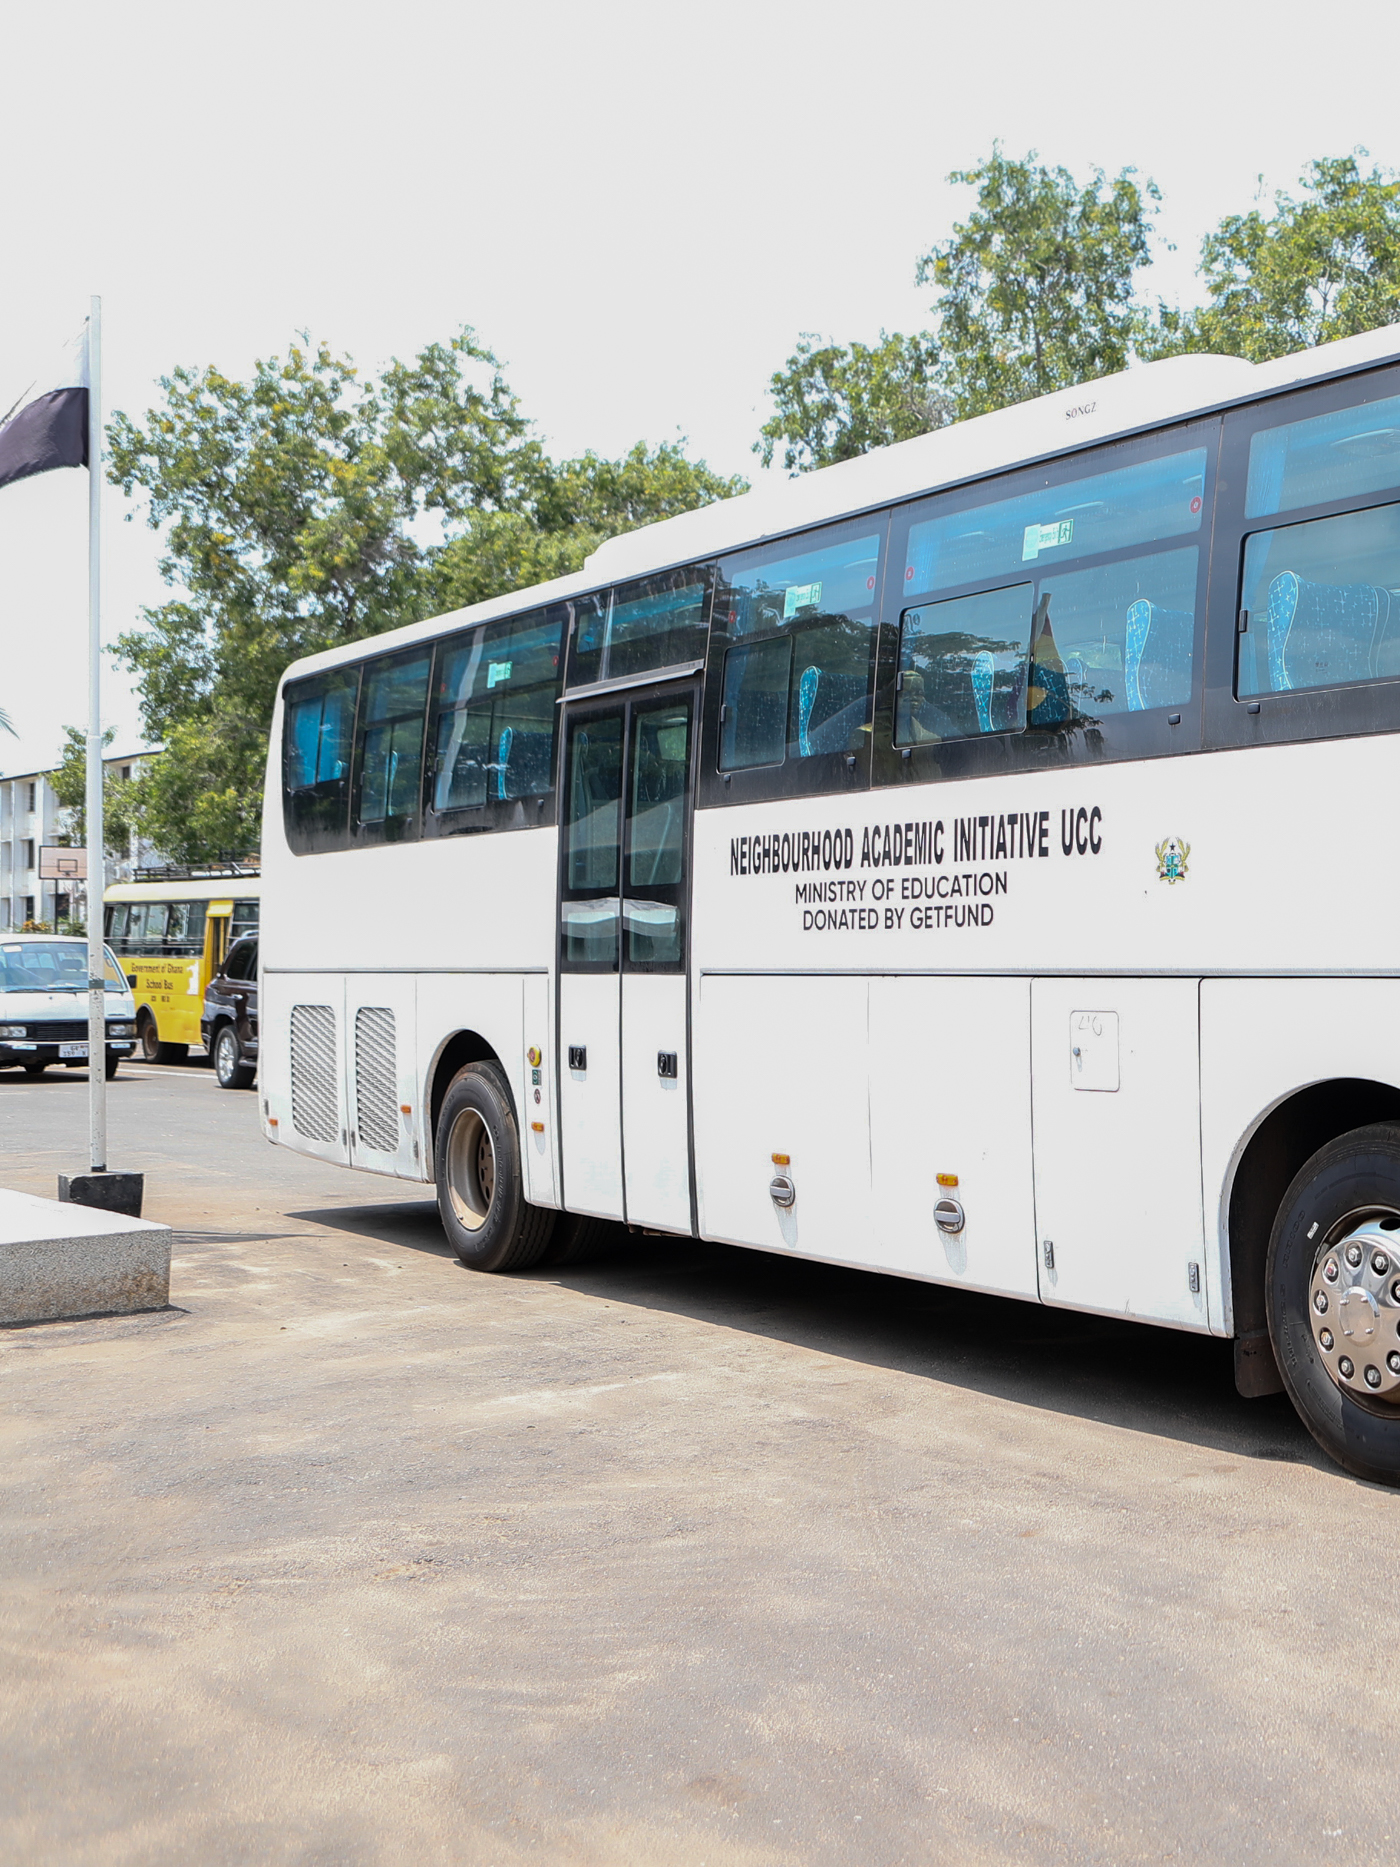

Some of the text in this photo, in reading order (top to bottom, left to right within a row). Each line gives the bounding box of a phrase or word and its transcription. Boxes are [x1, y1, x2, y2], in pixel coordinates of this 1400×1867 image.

[1065, 402, 1097, 420] SONGZ
[730, 806, 1103, 876] NEIGHBOURHOOD ACADEMIC INITIATIVE UCC
[795, 871, 1008, 904] MINISTRY OF EDUCATION
[803, 903, 994, 931] DONATED BY GETFUND
[145, 979, 174, 990] School Bus
